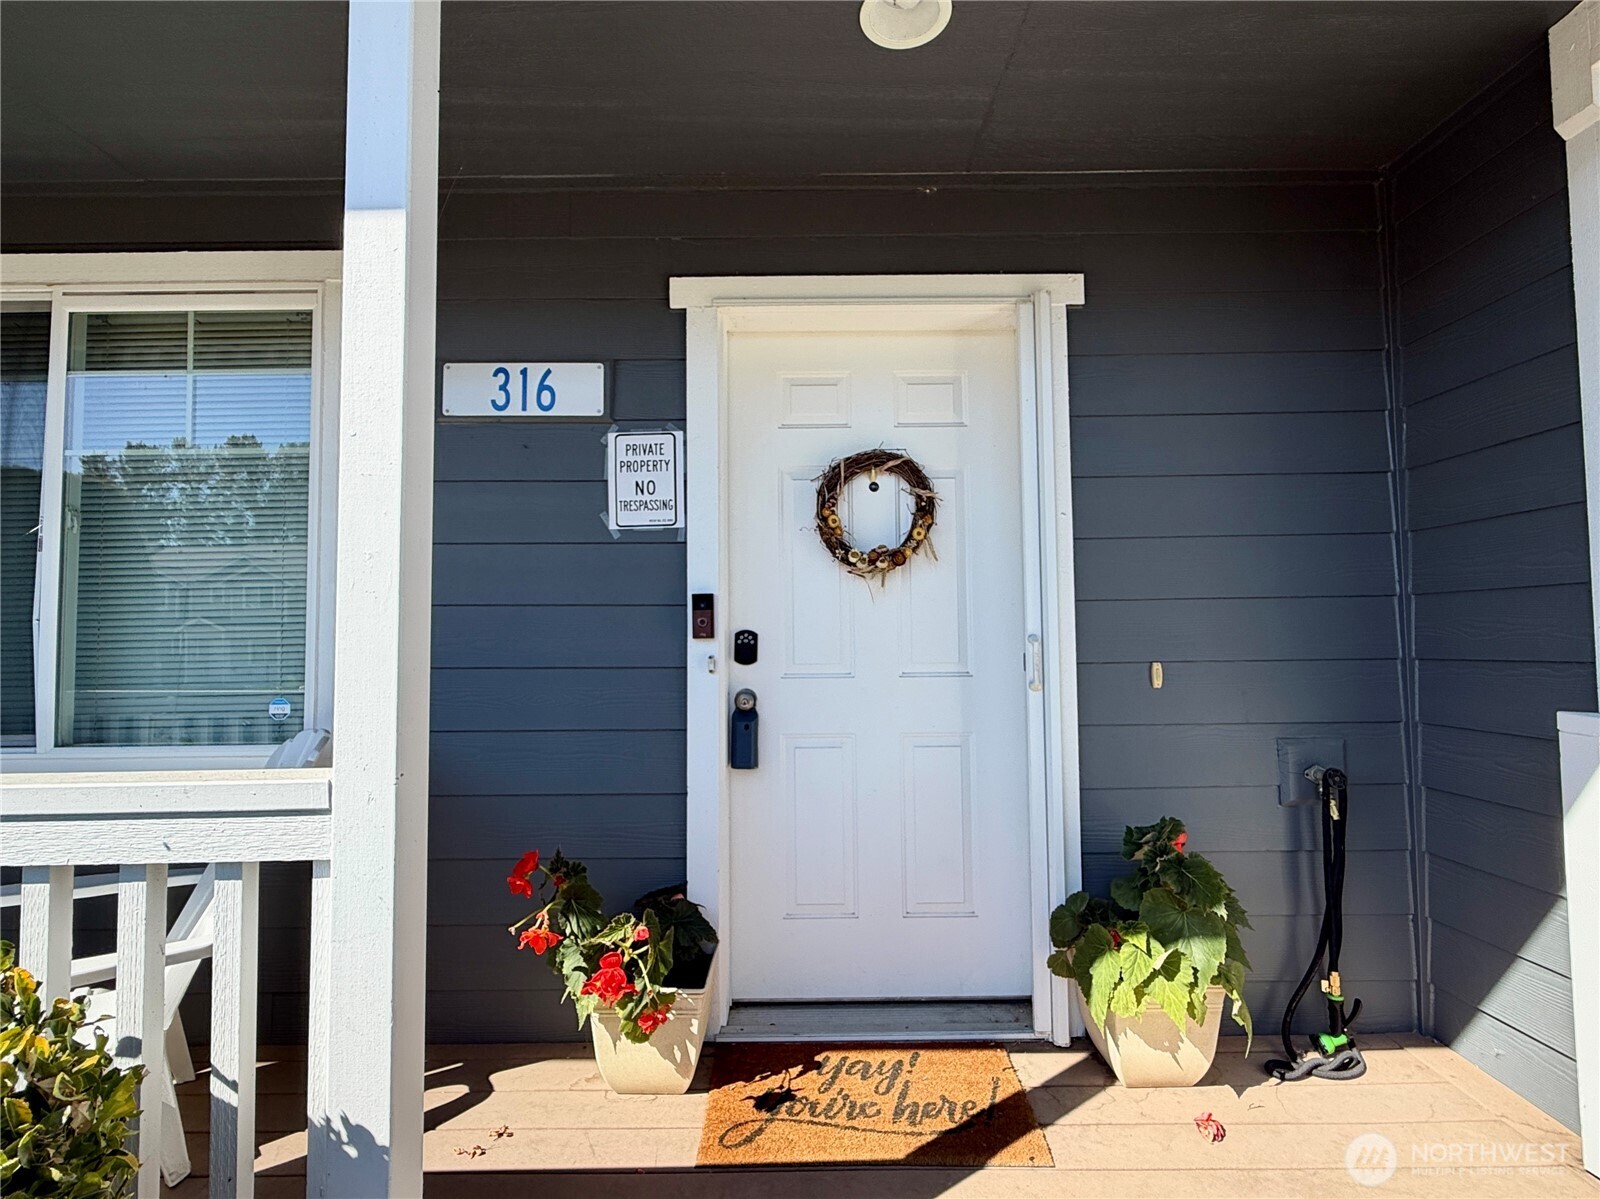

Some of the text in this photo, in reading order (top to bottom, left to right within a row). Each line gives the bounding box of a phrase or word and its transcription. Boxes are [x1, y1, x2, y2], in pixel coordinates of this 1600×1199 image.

[490, 366, 557, 412] 316
[625, 442, 665, 456] PRIVATE
[619, 459, 671, 473] PROPERTY
[635, 480, 656, 496] NO
[619, 498, 674, 512] TRESPASSING
